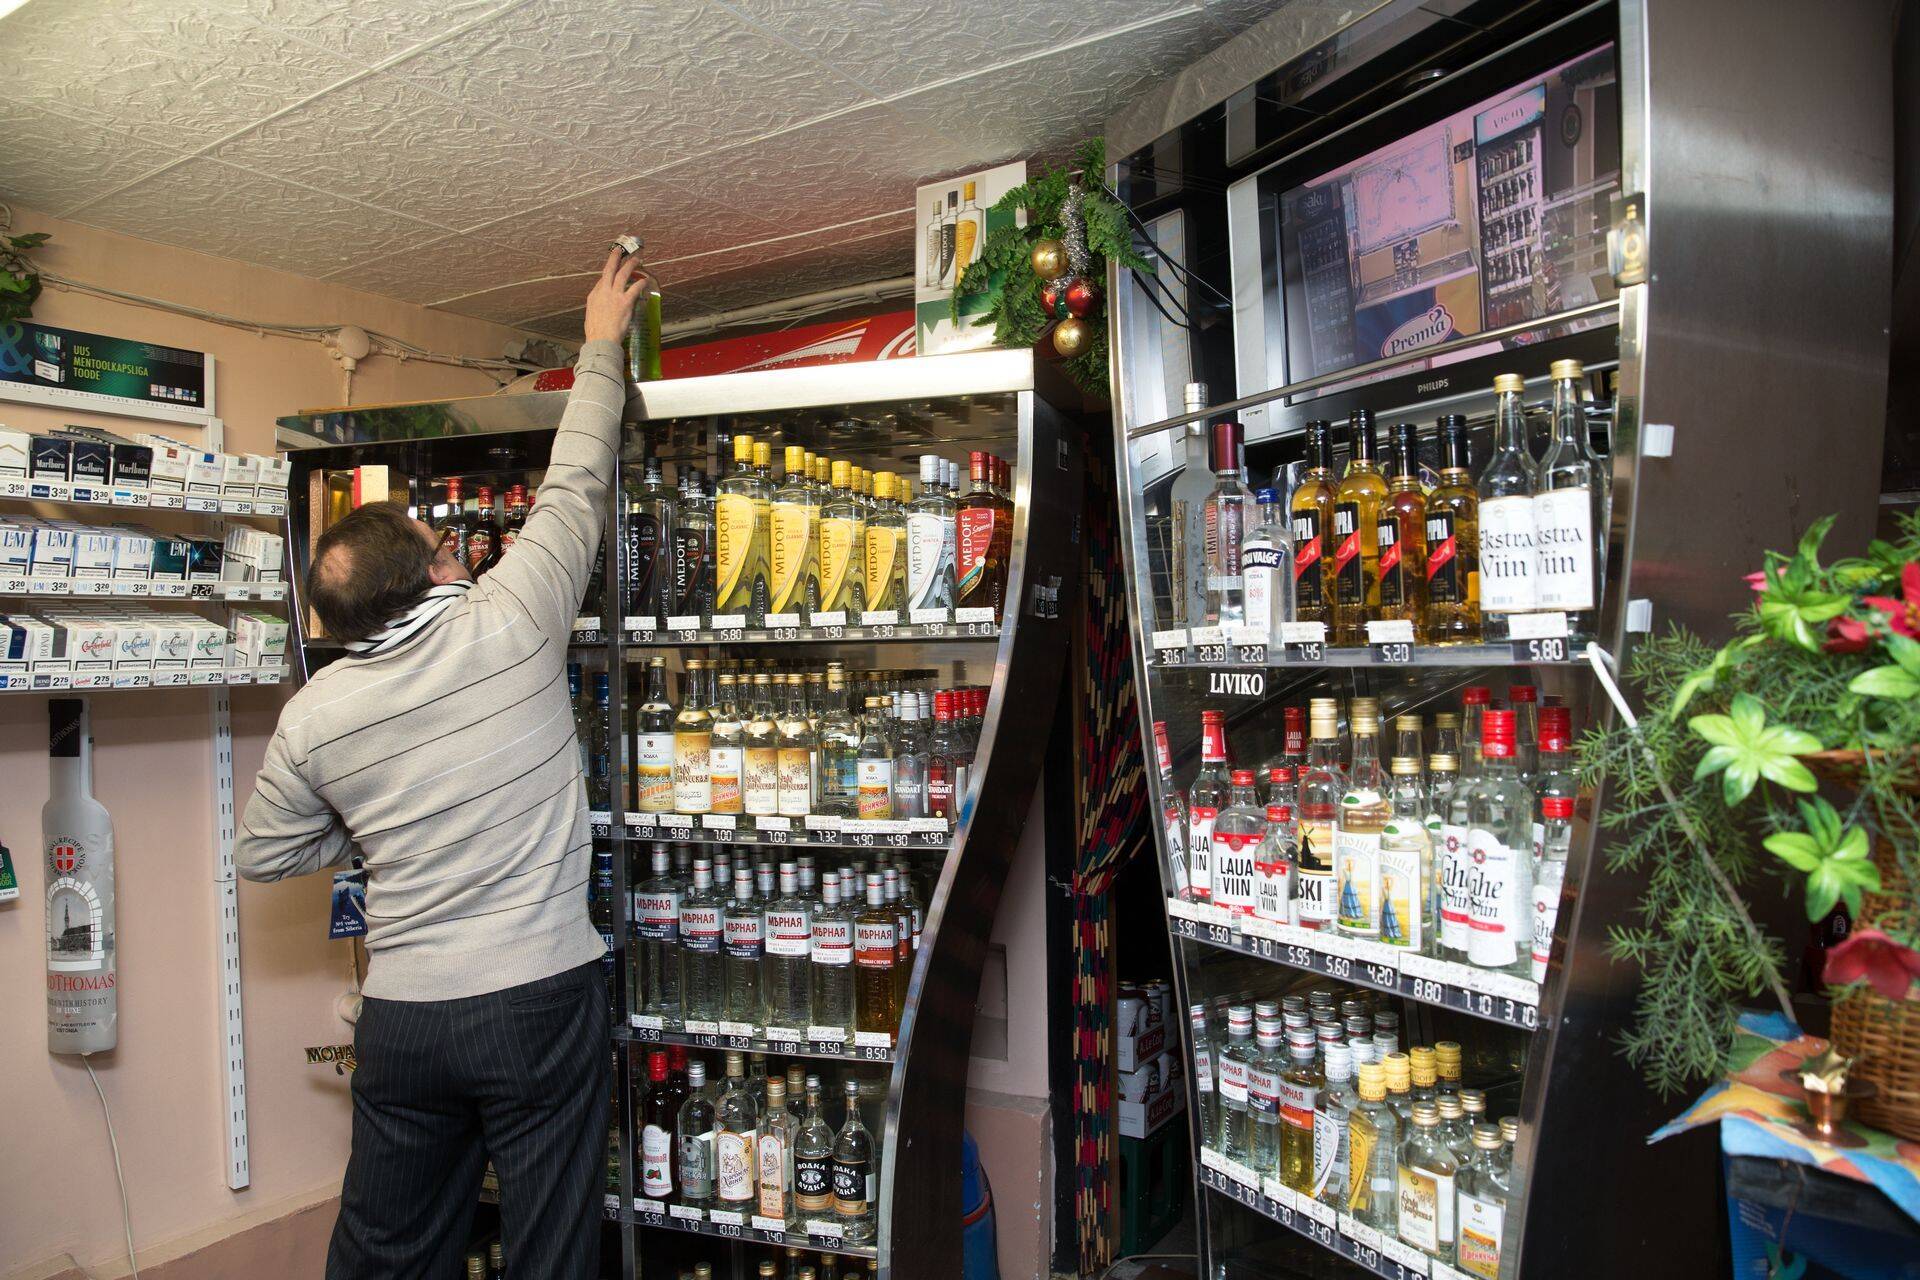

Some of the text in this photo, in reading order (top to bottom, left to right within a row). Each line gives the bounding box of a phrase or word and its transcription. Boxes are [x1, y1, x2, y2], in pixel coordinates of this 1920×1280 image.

[1391, 319, 1446, 354] Premia
[73, 345, 91, 357] UUS
[73, 355, 149, 377] MENTOOLKAPSLIGA
[73, 367, 101, 381] TOODE
[1417, 378, 1449, 393] PHILIPS
[36, 457, 65, 469] Marlboro
[77, 462, 105, 473] Marlboro
[119, 463, 149, 475] Marlboro
[719, 506, 729, 566] MEDOFF
[962, 515, 972, 567] MEDOFF
[629, 525, 639, 582] MEDOFF
[775, 518, 785, 575] MEDOFF
[823, 528, 831, 579] MEDOFF
[913, 522, 921, 575] MEDOFF
[676, 536, 685, 588] MEDOFF
[868, 535, 877, 582] MEDOFF
[1251, 551, 1279, 565] VALGE
[1481, 554, 1528, 578] Viin
[632, 631, 653, 642] 10.30
[679, 630, 696, 642] 7.90
[720, 629, 742, 640] 15.80
[774, 628, 797, 640] 10.30
[823, 626, 842, 638] 7.90
[873, 625, 894, 638] 5.30
[923, 624, 944, 636] 7.90
[968, 623, 990, 635] 8.10
[1162, 649, 1186, 664] 30.61
[1200, 646, 1225, 662] 20.39
[1240, 646, 1264, 662] 12.20
[1298, 643, 1320, 661] 7.45
[1382, 644, 1410, 661] 5.20
[1529, 638, 1563, 661] 5.80
[1210, 673, 1263, 696] LIVIKO
[635, 826, 653, 838] 9.80
[671, 827, 689, 839] 9.80
[714, 829, 732, 841] 7.00
[767, 831, 787, 843] 7.00
[817, 831, 836, 843] 7.32
[921, 832, 943, 845] 4.90
[852, 834, 873, 846] 4.90
[887, 834, 908, 847] 4.90
[1220, 857, 1254, 877] LAUA
[1223, 877, 1250, 896] VIIN
[1259, 882, 1278, 897] LAUA
[1262, 899, 1276, 912] VIIN
[1179, 919, 1196, 937] 5.90
[1209, 925, 1228, 943] 5.60
[1251, 937, 1272, 957] 3.70
[1288, 946, 1310, 966] 5.95
[1326, 955, 1349, 977] 5.60
[1367, 964, 1393, 987] 4.20
[1413, 978, 1441, 1002] 8.80
[1463, 990, 1492, 1015] 7.10
[1504, 999, 1536, 1027] 3.10
[695, 1035, 717, 1047] 11.40
[730, 1037, 749, 1048] 8.20
[774, 1043, 797, 1054] 11.80
[820, 1042, 840, 1054] 8.50
[866, 1048, 887, 1060] 8.50
[1315, 1118, 1323, 1171] MEDOFF
[1208, 1168, 1226, 1190] 3.70
[1236, 1184, 1255, 1206] 3.70
[1271, 1201, 1291, 1225] 3.70
[719, 1224, 741, 1237] 10.00
[763, 1230, 783, 1243] 7.40
[1309, 1219, 1331, 1245] 3.40
[819, 1236, 839, 1248] 7.20
[1353, 1241, 1377, 1268] 3.40
